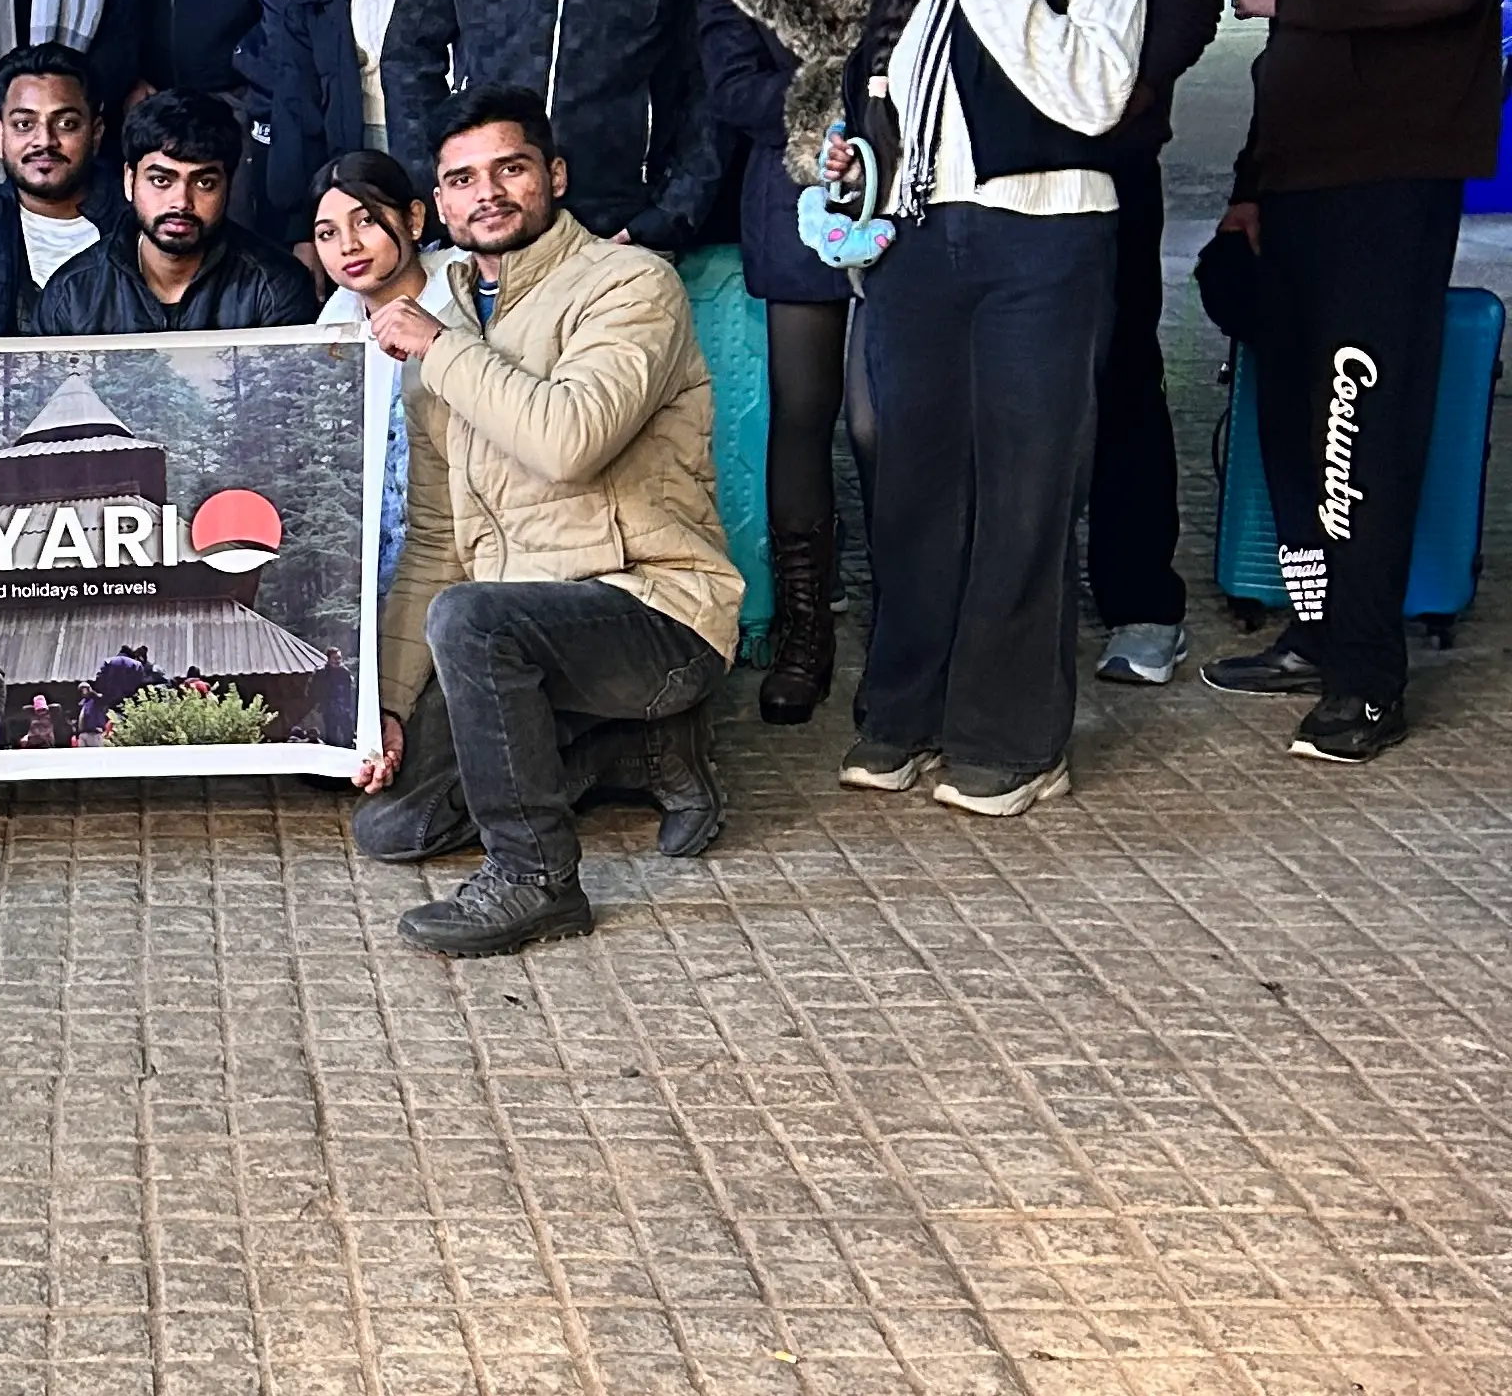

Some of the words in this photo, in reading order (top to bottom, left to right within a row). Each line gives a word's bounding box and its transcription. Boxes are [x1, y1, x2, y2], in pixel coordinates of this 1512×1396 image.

[11, 582, 79, 600] holidays
[83, 582, 99, 596] to
[103, 580, 157, 595] travels
